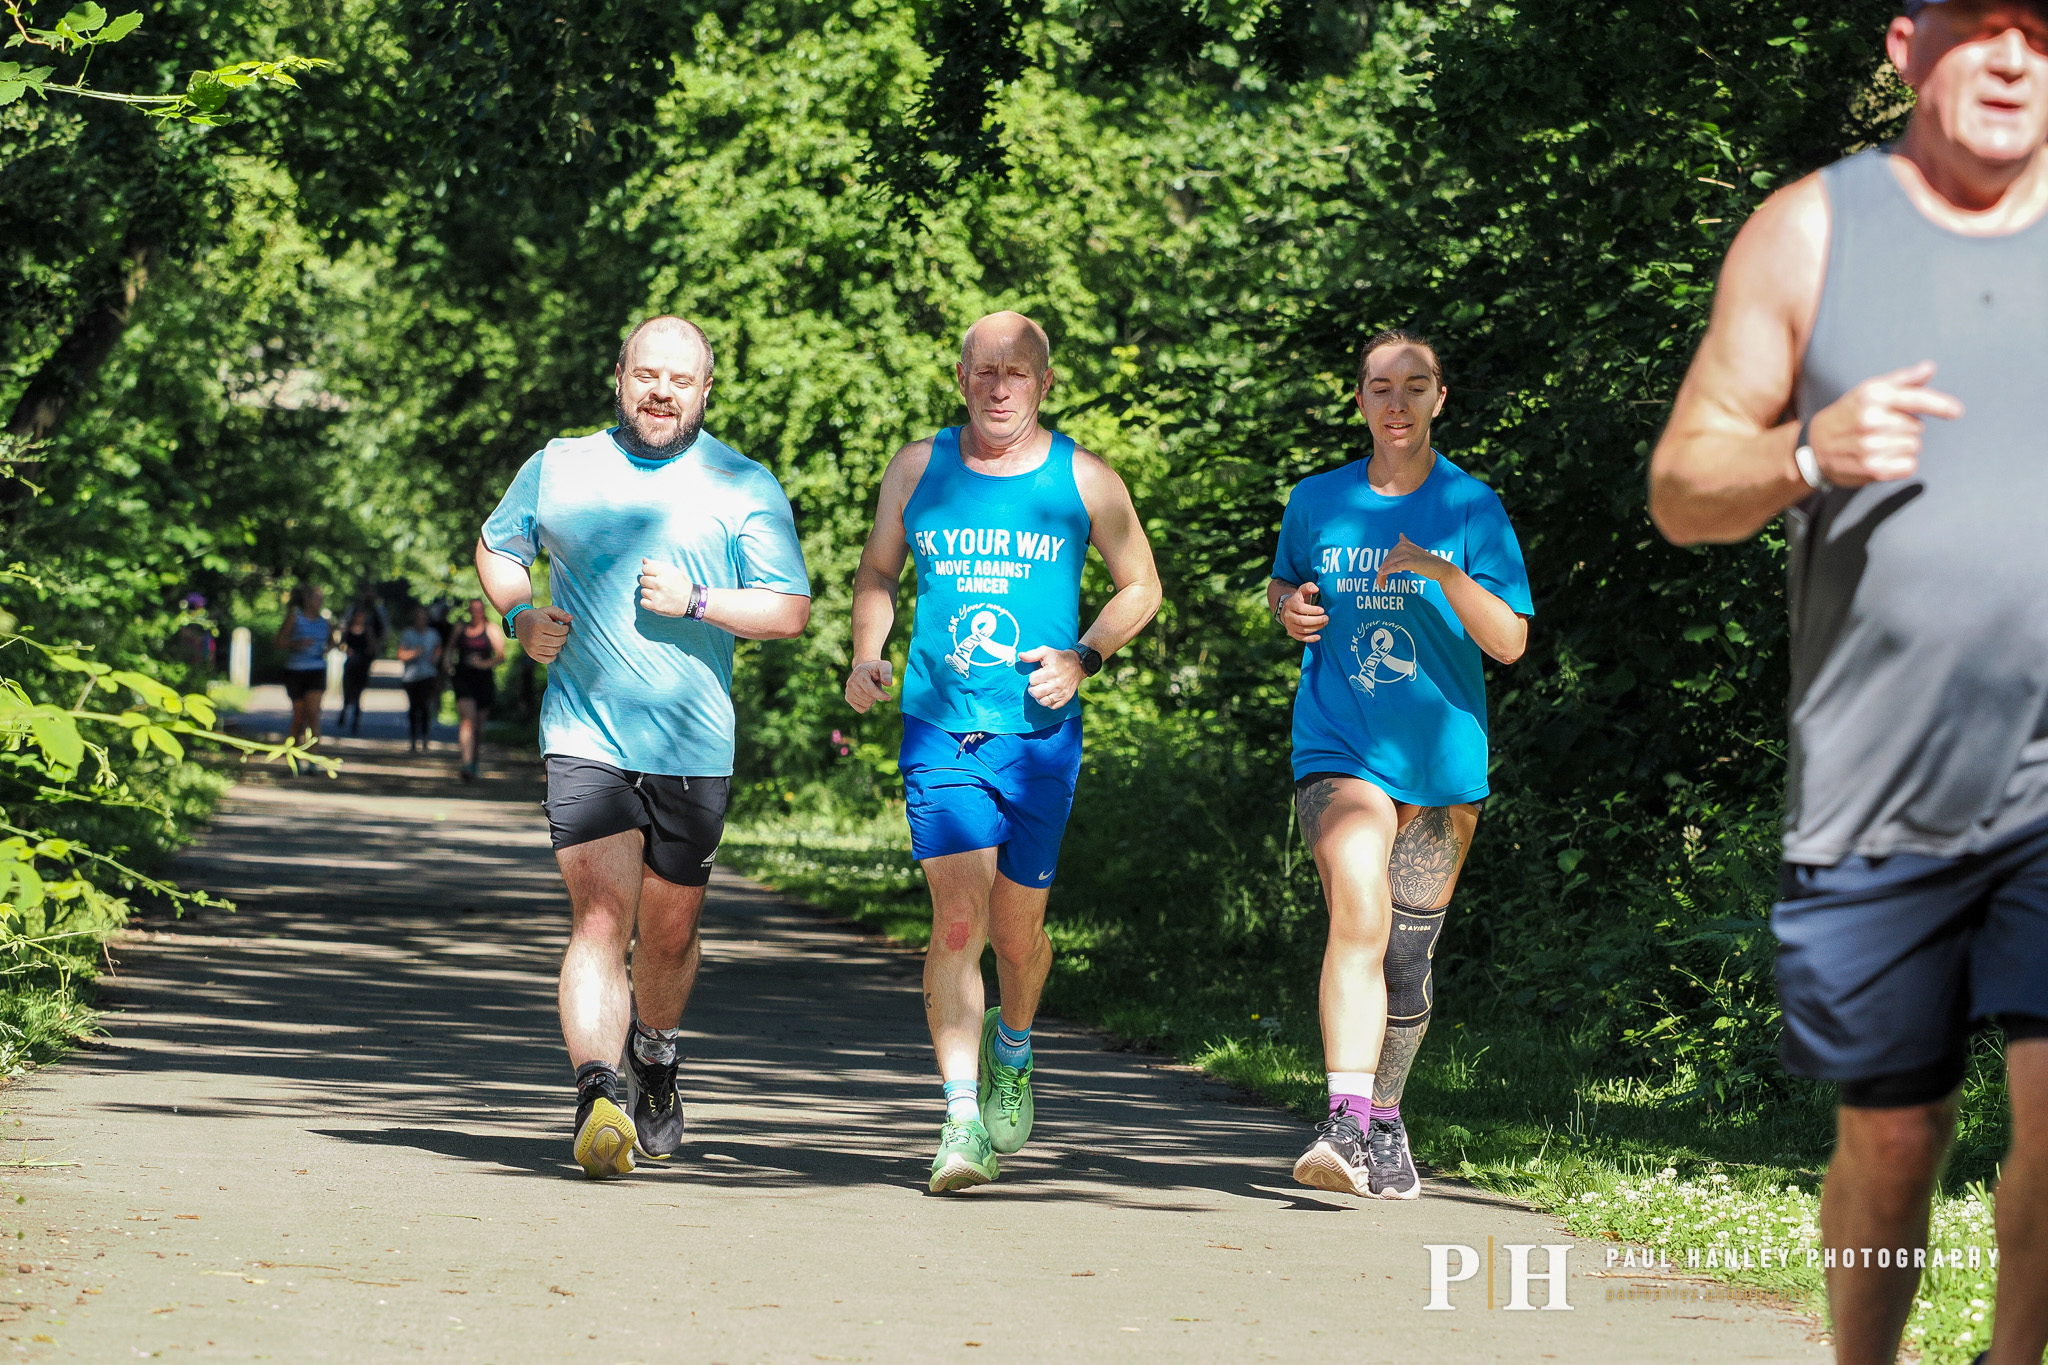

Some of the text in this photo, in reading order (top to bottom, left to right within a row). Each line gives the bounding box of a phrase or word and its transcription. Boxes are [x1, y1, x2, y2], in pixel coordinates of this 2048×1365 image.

[915, 528, 1066, 562] 5K YOUR WAY
[935, 559, 1032, 579] MOVE AGAINST
[1321, 547, 1343, 574] 5K
[1346, 547, 1403, 574] YOU
[956, 577, 1008, 594] CANCER
[1336, 578, 1369, 593] MOVE
[959, 603, 986, 621] Your
[1356, 595, 1405, 611] CANCER
[1357, 619, 1381, 639] Your
[955, 629, 991, 665] MOVE
[1360, 645, 1391, 683] MOVE
